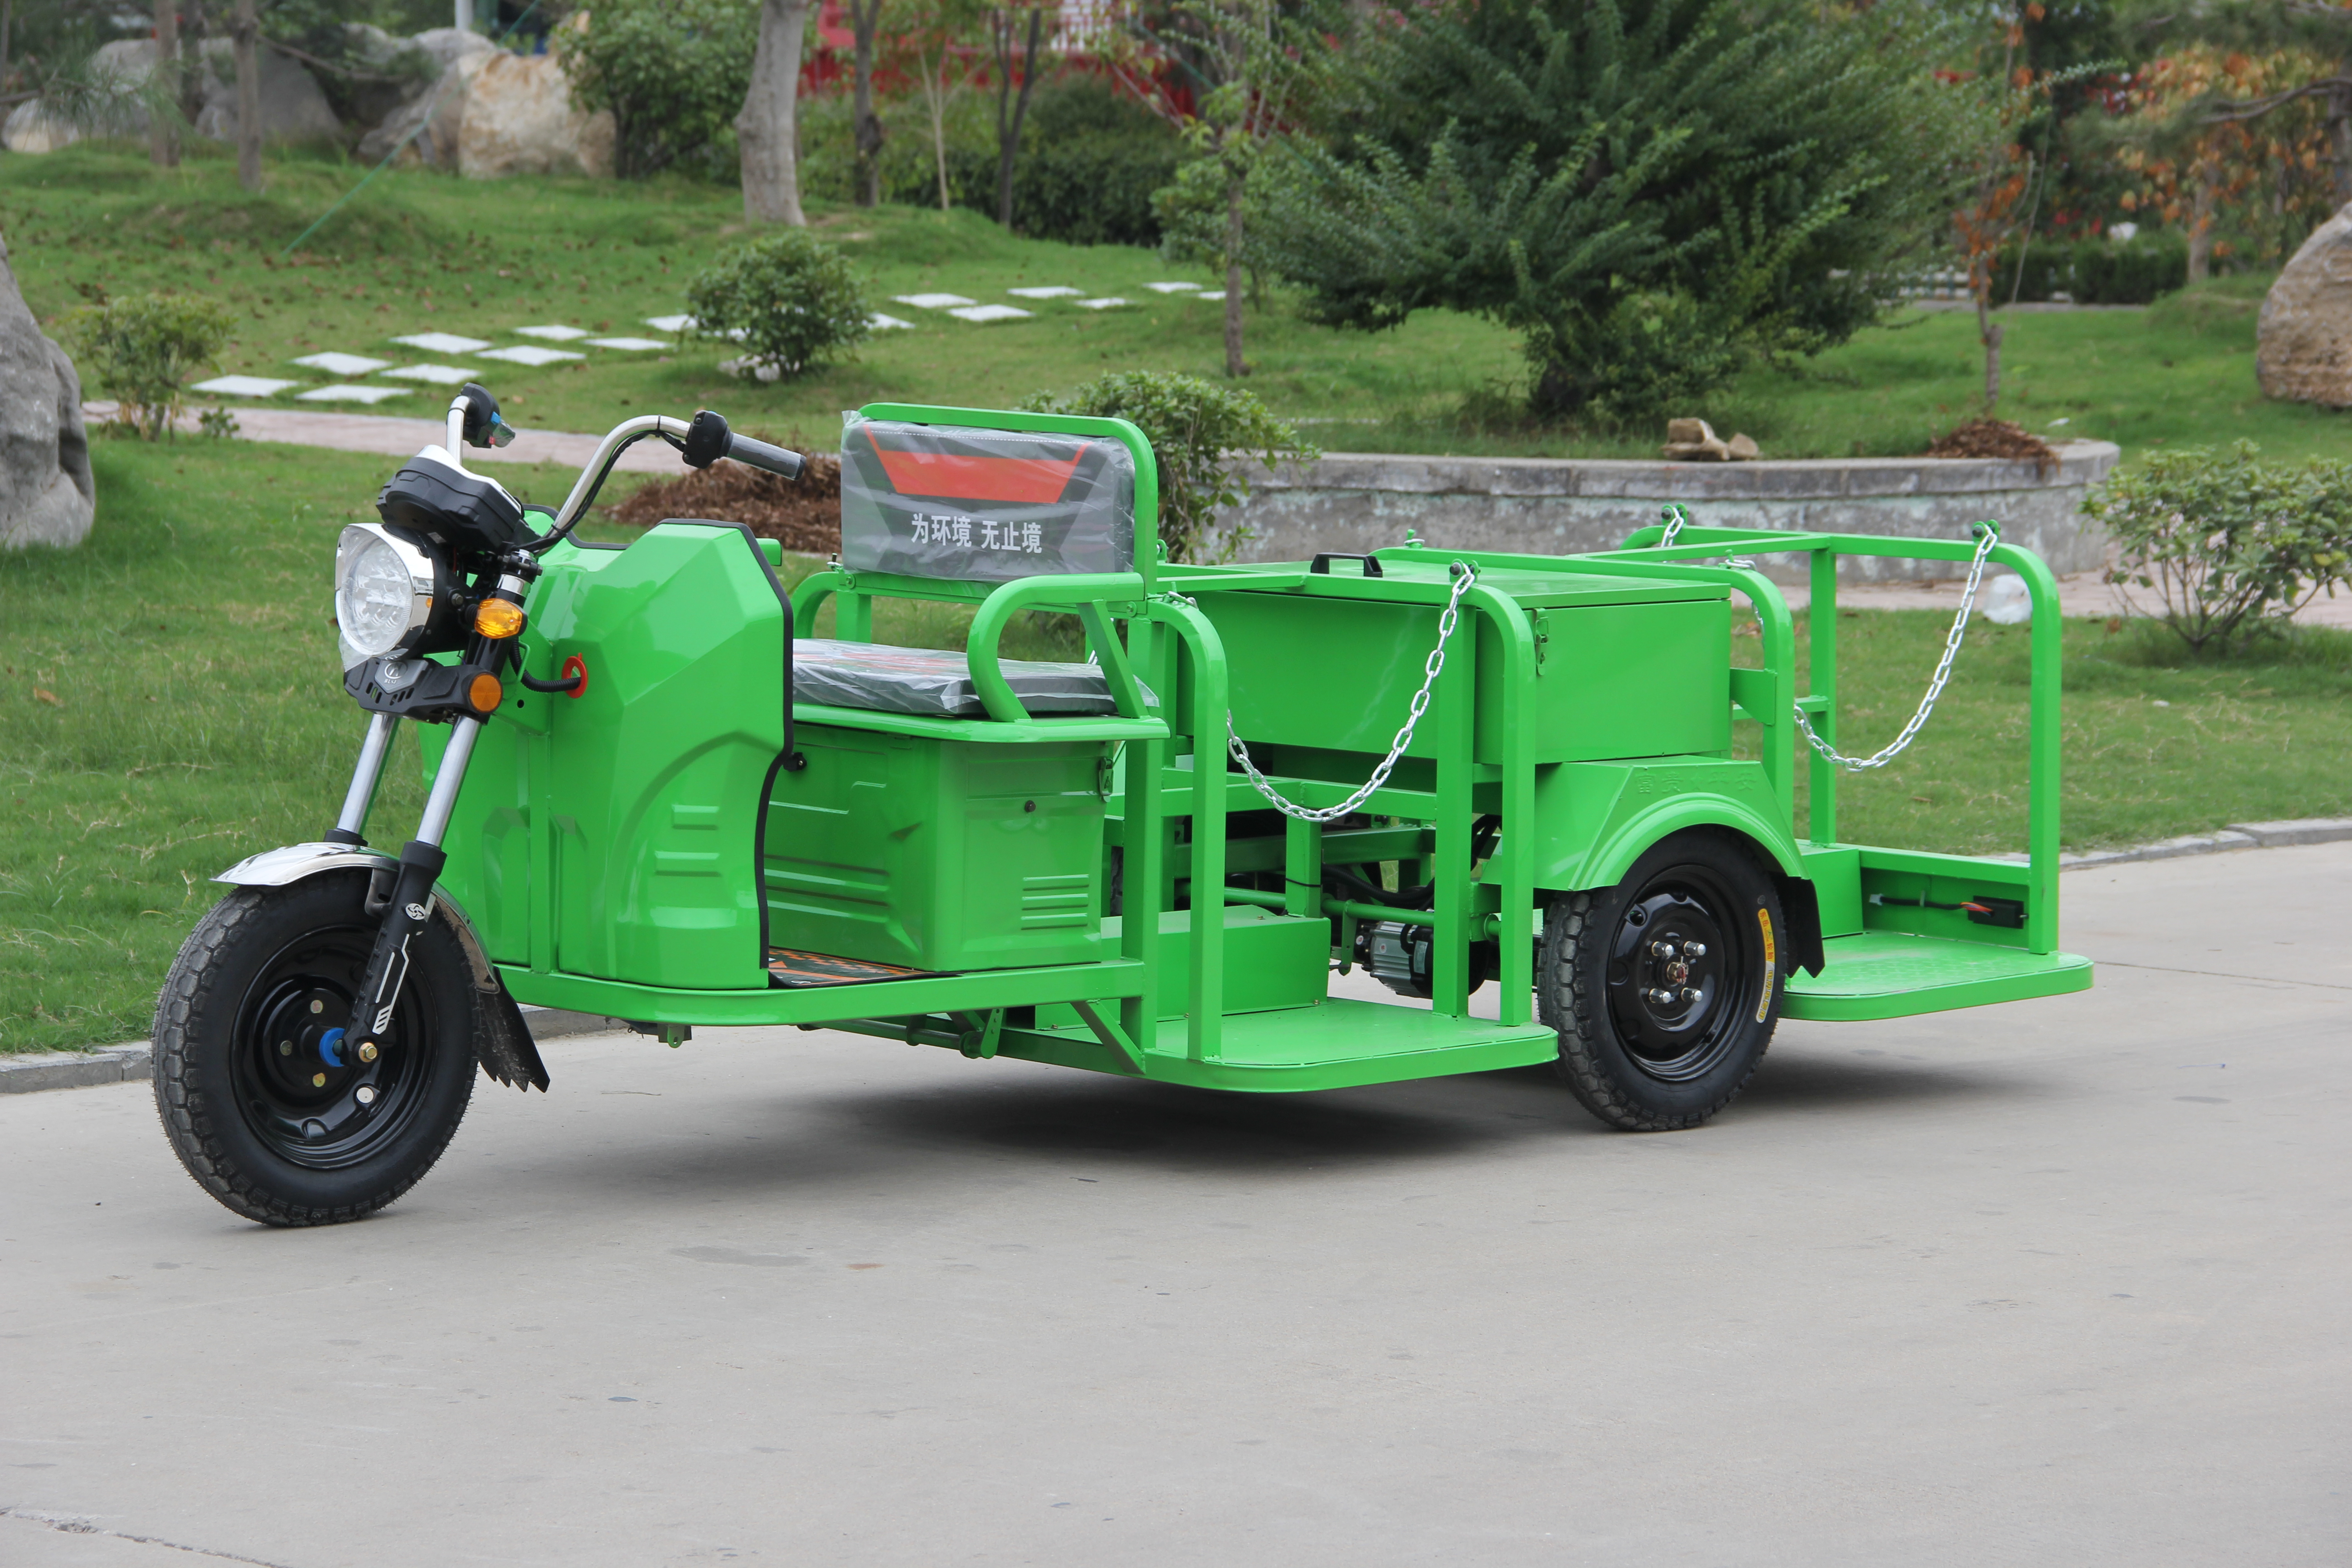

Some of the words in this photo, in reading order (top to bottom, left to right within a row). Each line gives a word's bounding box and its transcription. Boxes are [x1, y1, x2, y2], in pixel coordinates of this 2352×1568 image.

[911, 513, 972, 547] 为环境
[981, 520, 1043, 554] 无止境
[1766, 943, 1774, 960] 轮胎
